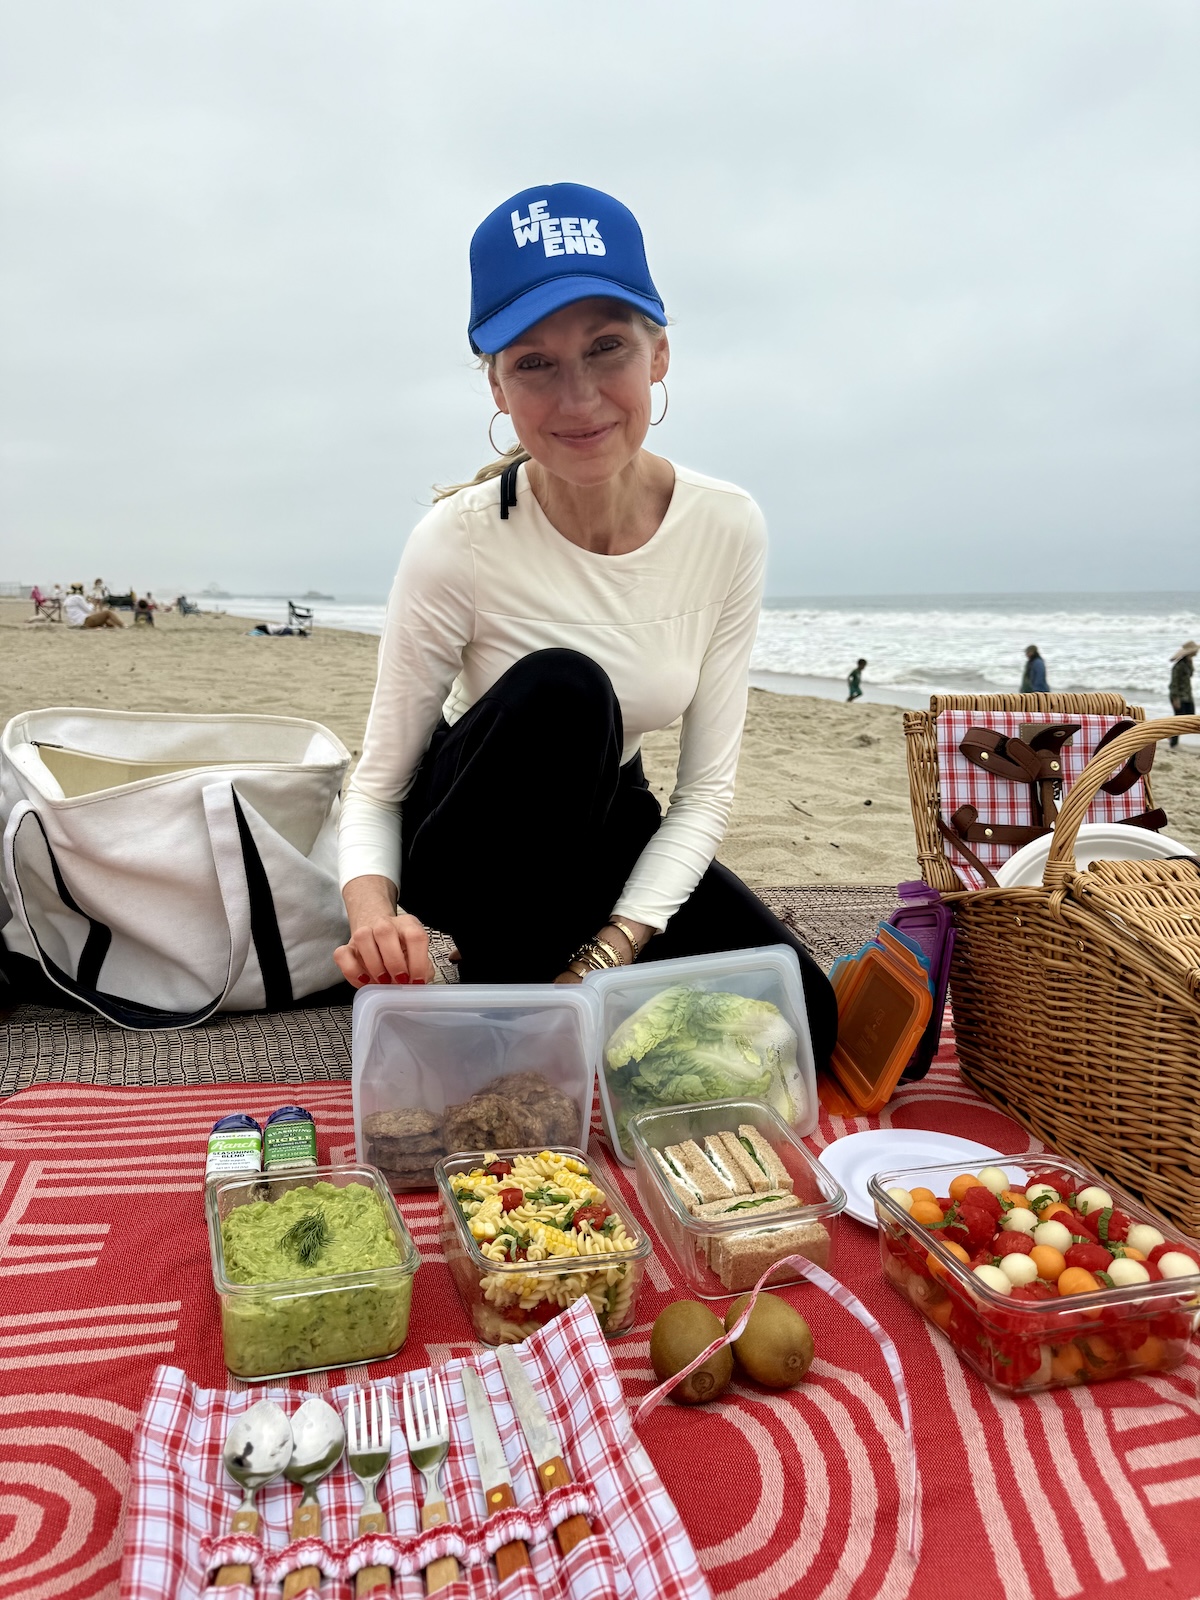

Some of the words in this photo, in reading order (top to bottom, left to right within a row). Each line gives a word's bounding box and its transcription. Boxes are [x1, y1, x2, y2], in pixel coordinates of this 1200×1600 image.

[510, 200, 550, 230] LE
[513, 217, 602, 248] WEEK
[543, 236, 606, 258] END
[210, 1139, 258, 1151] Ranch
[267, 1135, 313, 1145] PICKLE
